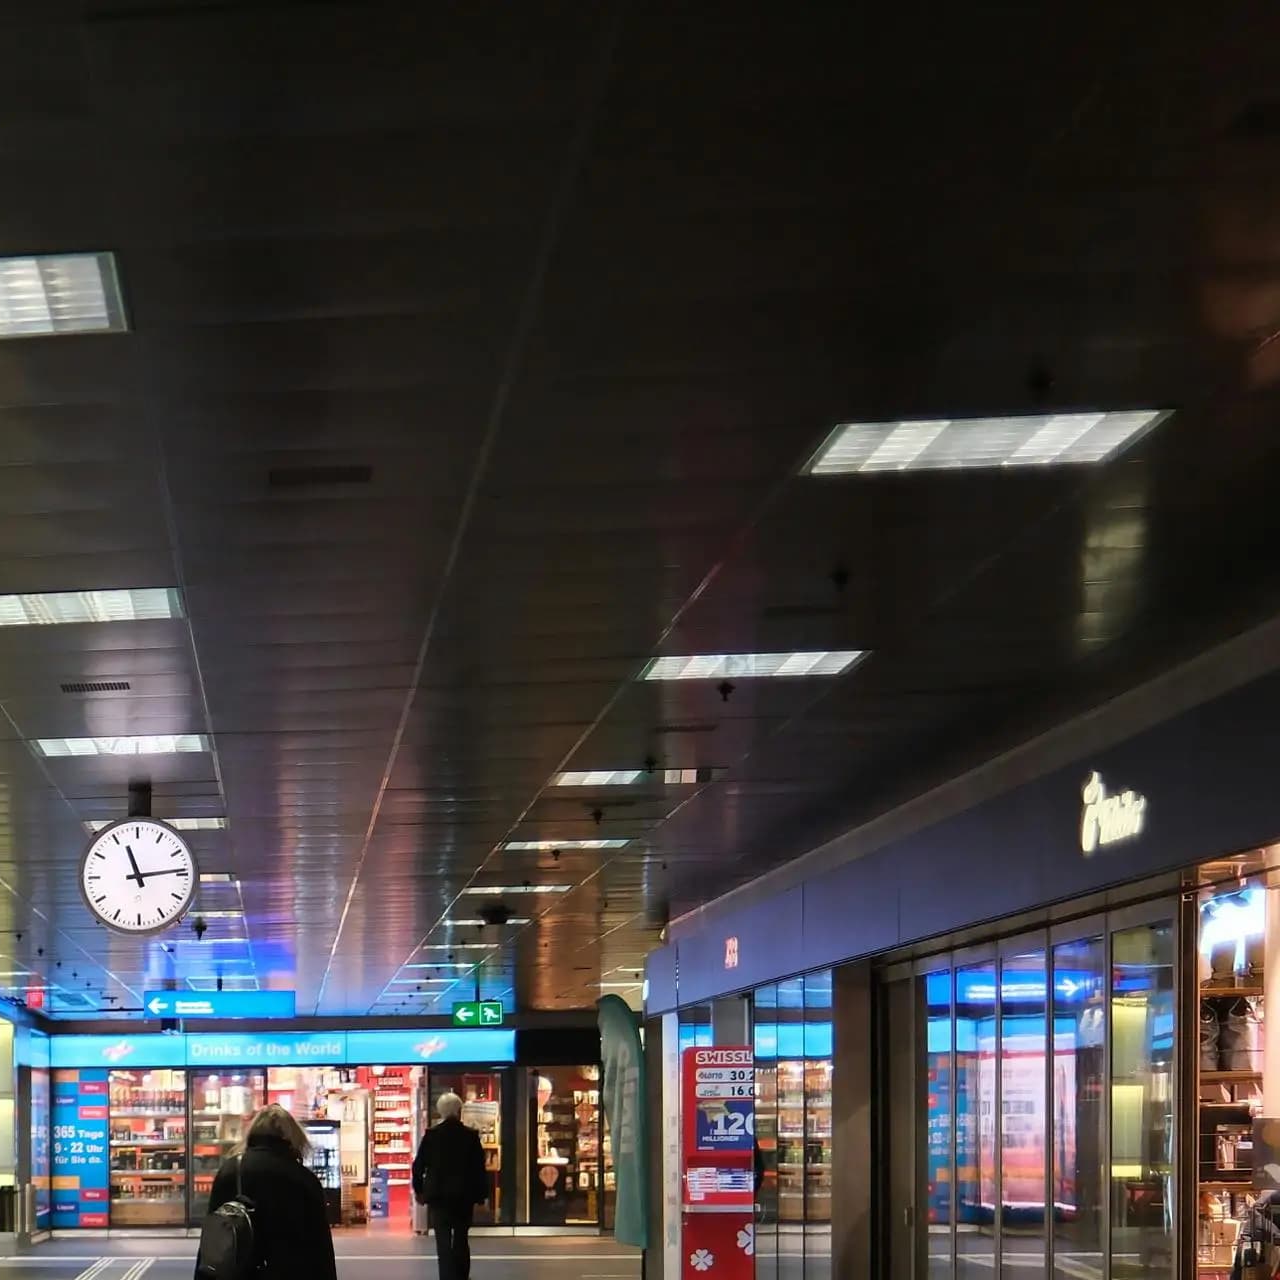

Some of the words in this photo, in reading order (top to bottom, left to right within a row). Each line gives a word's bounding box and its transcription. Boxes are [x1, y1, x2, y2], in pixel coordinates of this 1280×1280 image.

[192, 1043, 240, 1056] Drinks
[247, 1043, 263, 1056] of
[266, 1043, 289, 1056] the
[296, 1042, 340, 1055] World
[697, 1051, 753, 1063] SWISSL
[54, 1126, 75, 1139] 365
[78, 1129, 104, 1141] Tage
[70, 1142, 83, 1153] 22
[87, 1143, 104, 1153] Uhr
[54, 1155, 68, 1164] für
[71, 1155, 86, 1164] Sie
